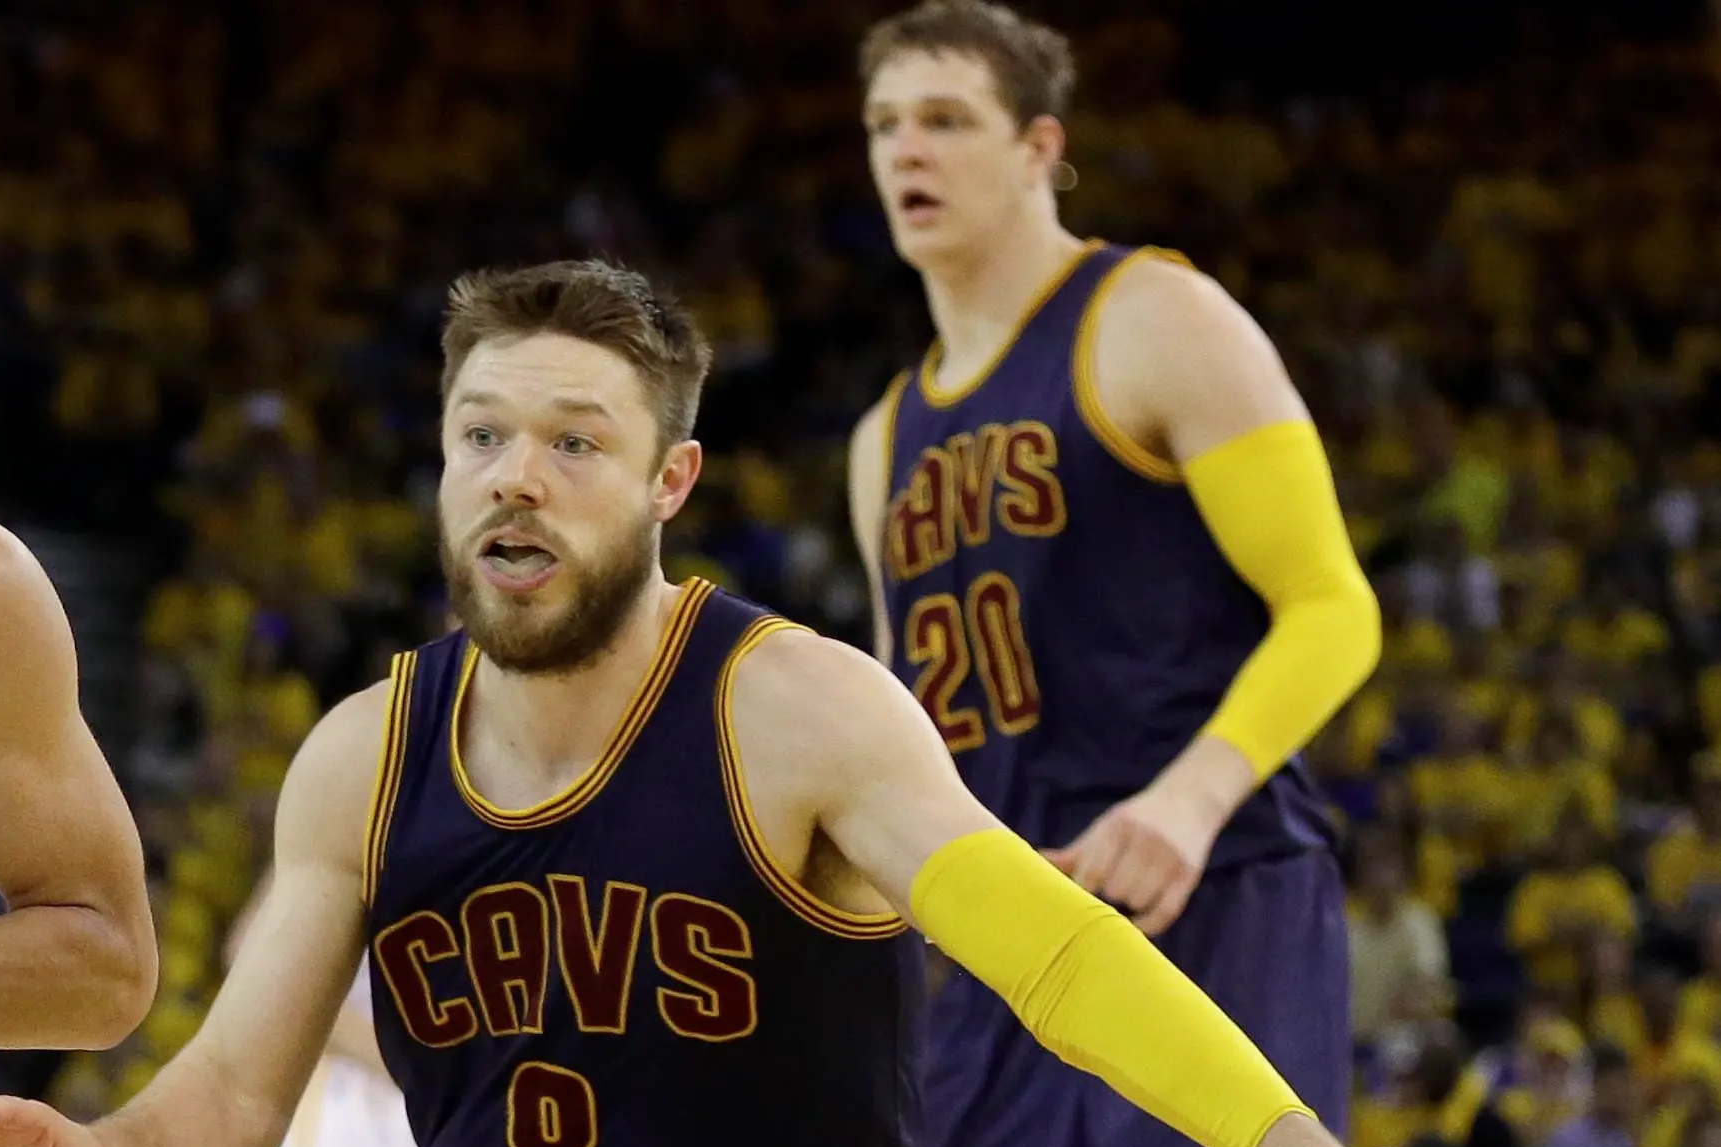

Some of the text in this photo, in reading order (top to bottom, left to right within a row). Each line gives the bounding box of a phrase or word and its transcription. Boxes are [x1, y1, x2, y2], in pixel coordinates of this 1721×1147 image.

[886, 419, 1068, 580] AVS
[904, 571, 1041, 752] 20
[375, 873, 758, 1048] CAVS
